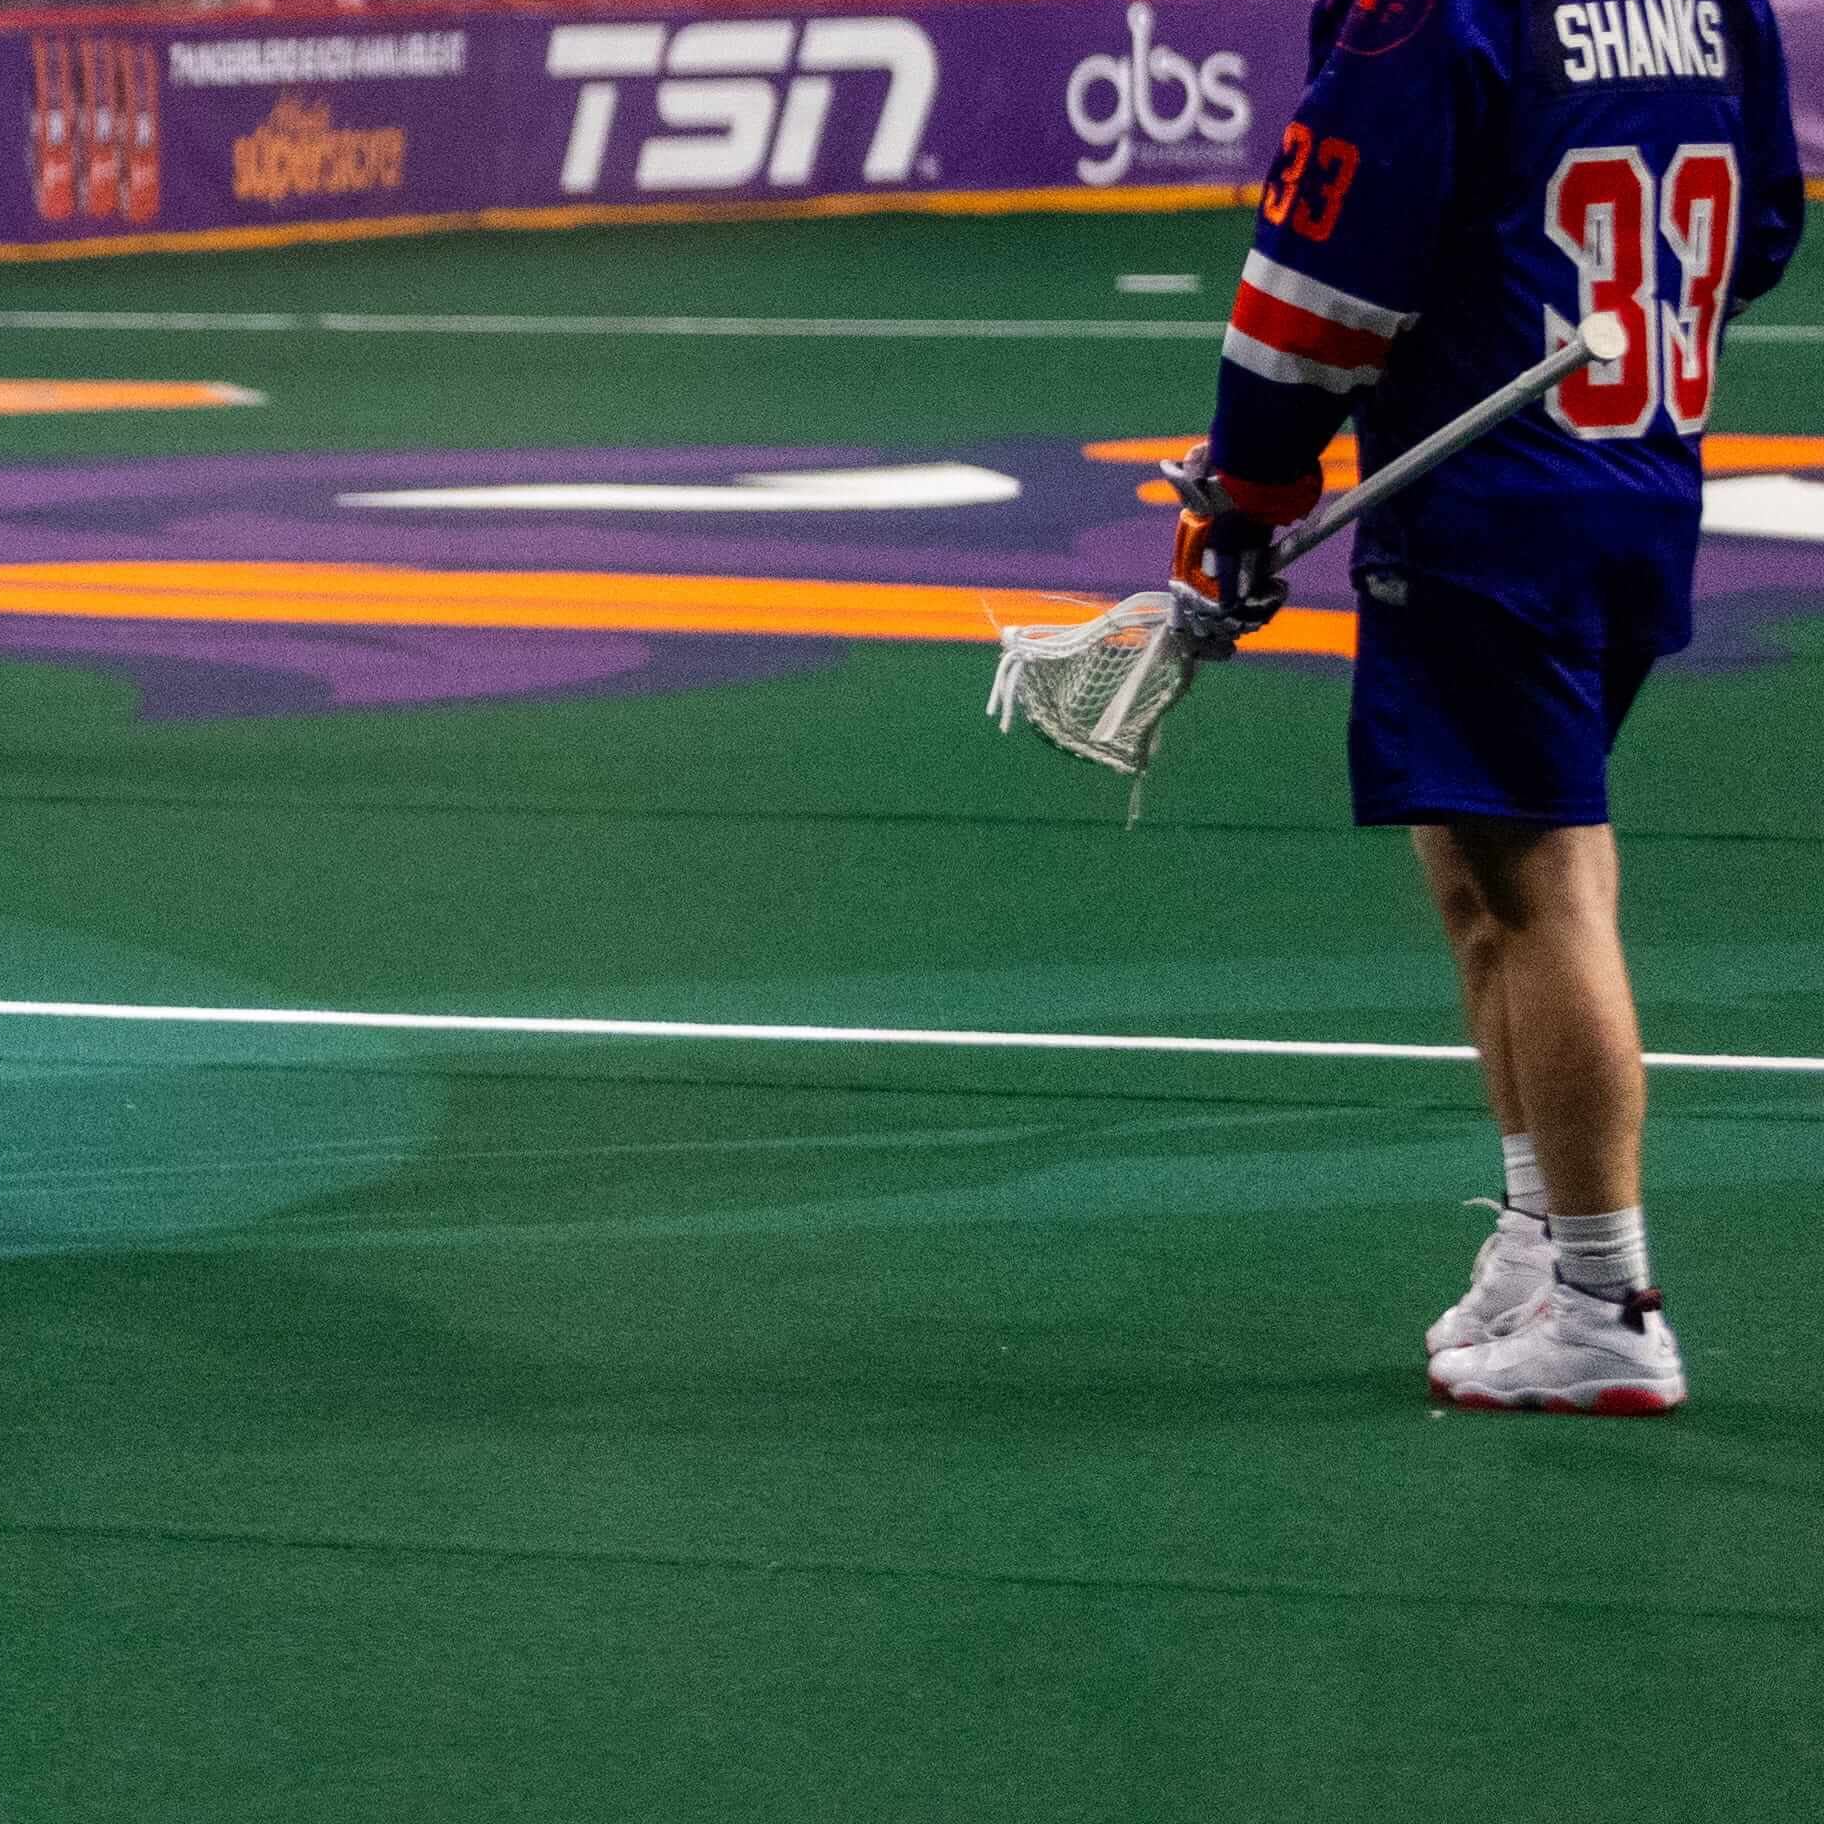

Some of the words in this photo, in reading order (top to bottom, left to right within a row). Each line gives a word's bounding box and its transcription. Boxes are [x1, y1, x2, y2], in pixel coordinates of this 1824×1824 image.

[545, 14, 940, 195] TSN
[1065, 0, 1252, 187] gbs
[1263, 120, 1360, 243] 33
[1544, 142, 1742, 441] 33
